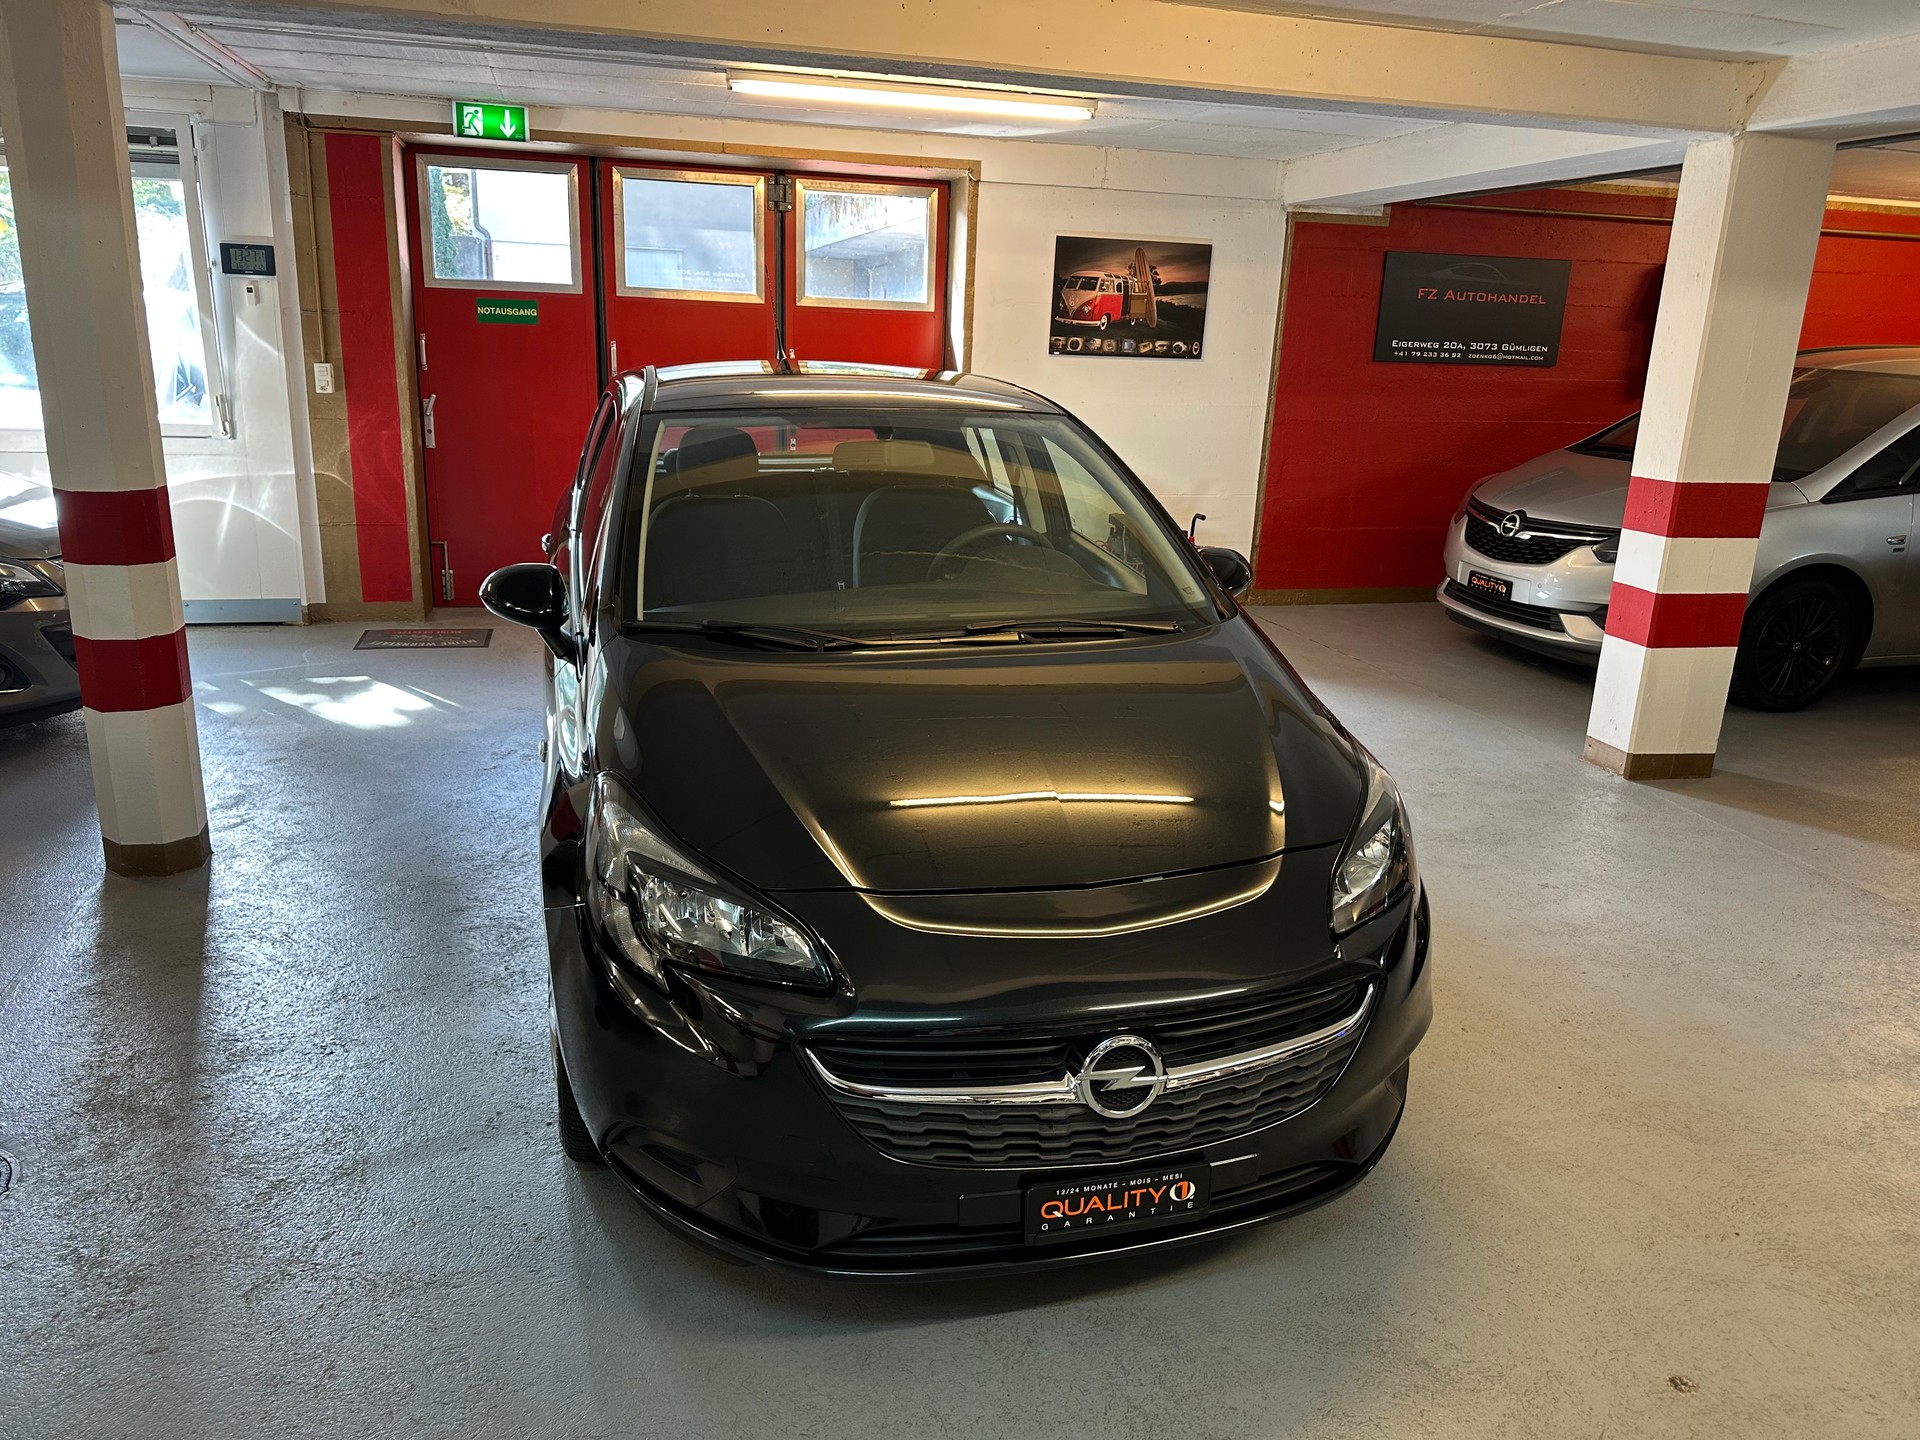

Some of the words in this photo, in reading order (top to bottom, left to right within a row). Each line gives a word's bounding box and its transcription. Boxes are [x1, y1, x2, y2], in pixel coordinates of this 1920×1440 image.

[1417, 288, 1438, 300] FZ
[1444, 289, 1546, 305] AUTOHANDEL
[478, 306, 537, 316] NOTAUSGANG
[1392, 339, 1440, 348] EIGERWEG
[1470, 342, 1498, 350] 3073
[1502, 343, 1548, 352] GÜMLIGEN
[1472, 576, 1499, 590] QUALITY
[1056, 1188, 1080, 1196] 12/24
[1084, 1182, 1118, 1192] MONATE
[1130, 1178, 1152, 1186] MOIS
[1162, 1172, 1183, 1181] MESI
[1040, 1185, 1167, 1220] QUALITY
[1042, 1202, 1194, 1230] GARANTIE
